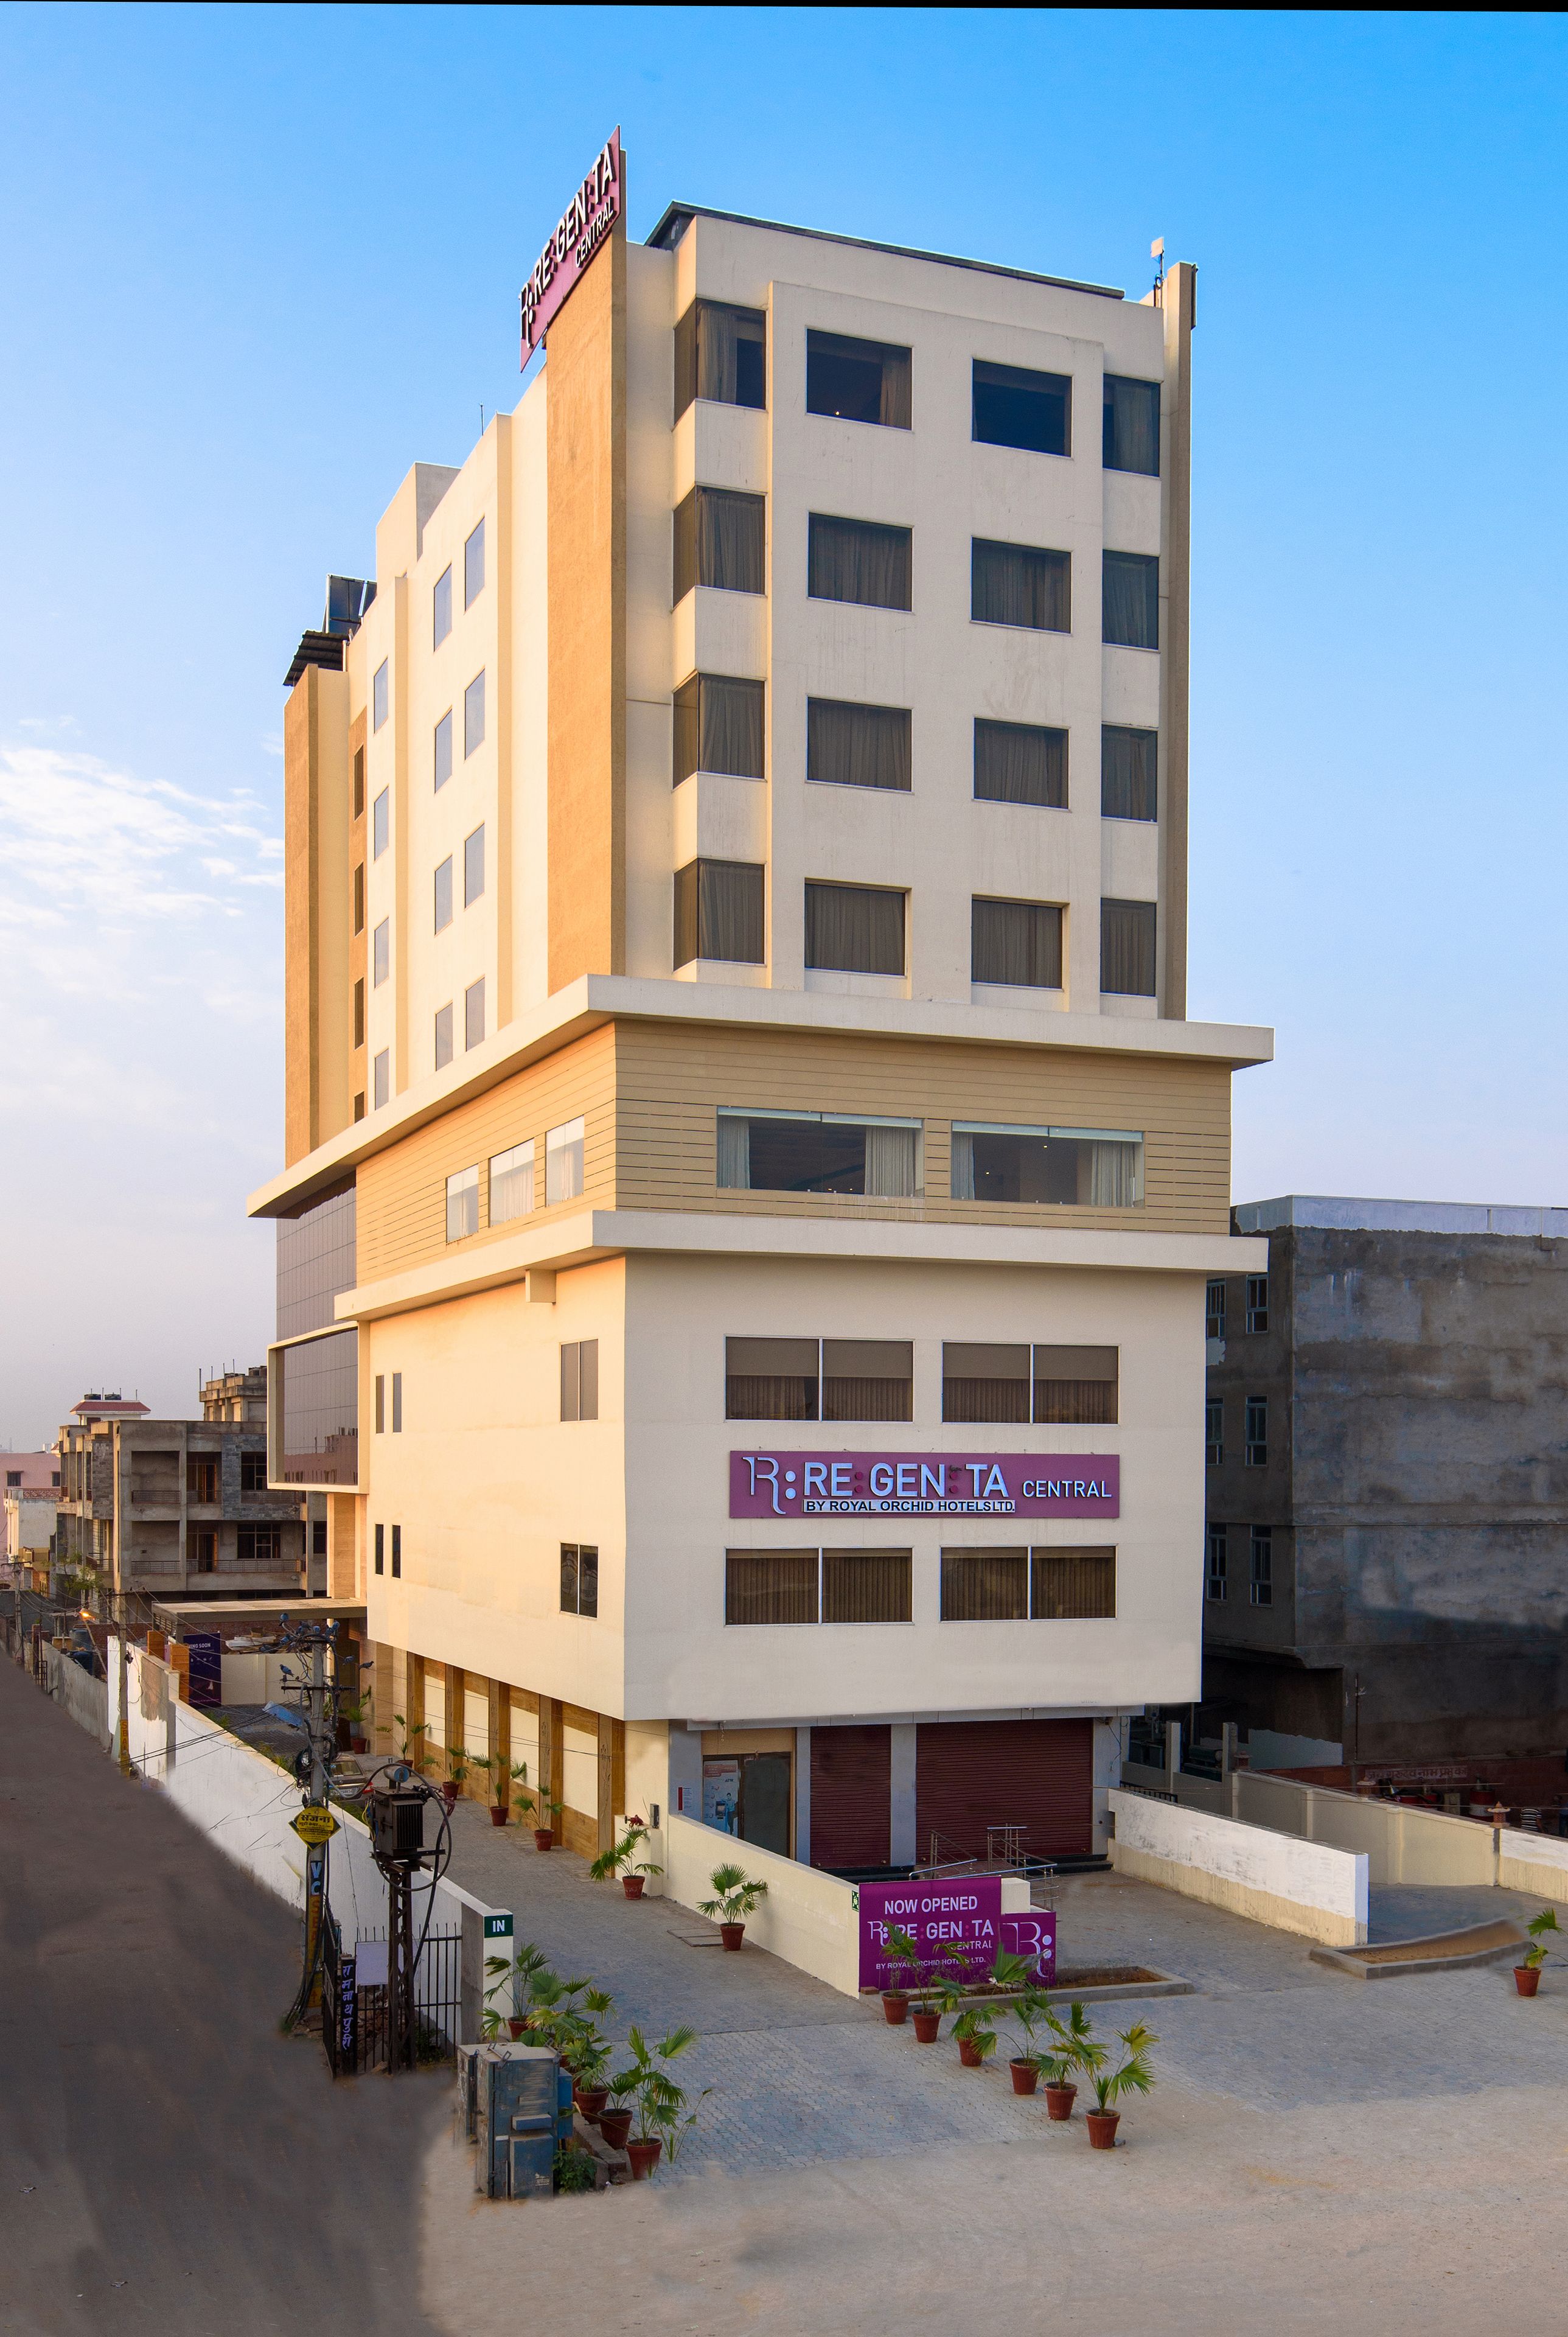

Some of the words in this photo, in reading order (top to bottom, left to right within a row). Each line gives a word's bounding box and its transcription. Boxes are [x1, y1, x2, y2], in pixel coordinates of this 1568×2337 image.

[575, 196, 614, 268] CENTRAL
[1022, 1480, 1112, 1498] CENTRAL
[806, 1501, 826, 1511] BY
[829, 1501, 877, 1511] ROYAL
[880, 1501, 935, 1511] ORCHID
[885, 1899, 918, 1915] NOW
[921, 1896, 978, 1913] OPENED
[492, 1920, 505, 1932] IN
